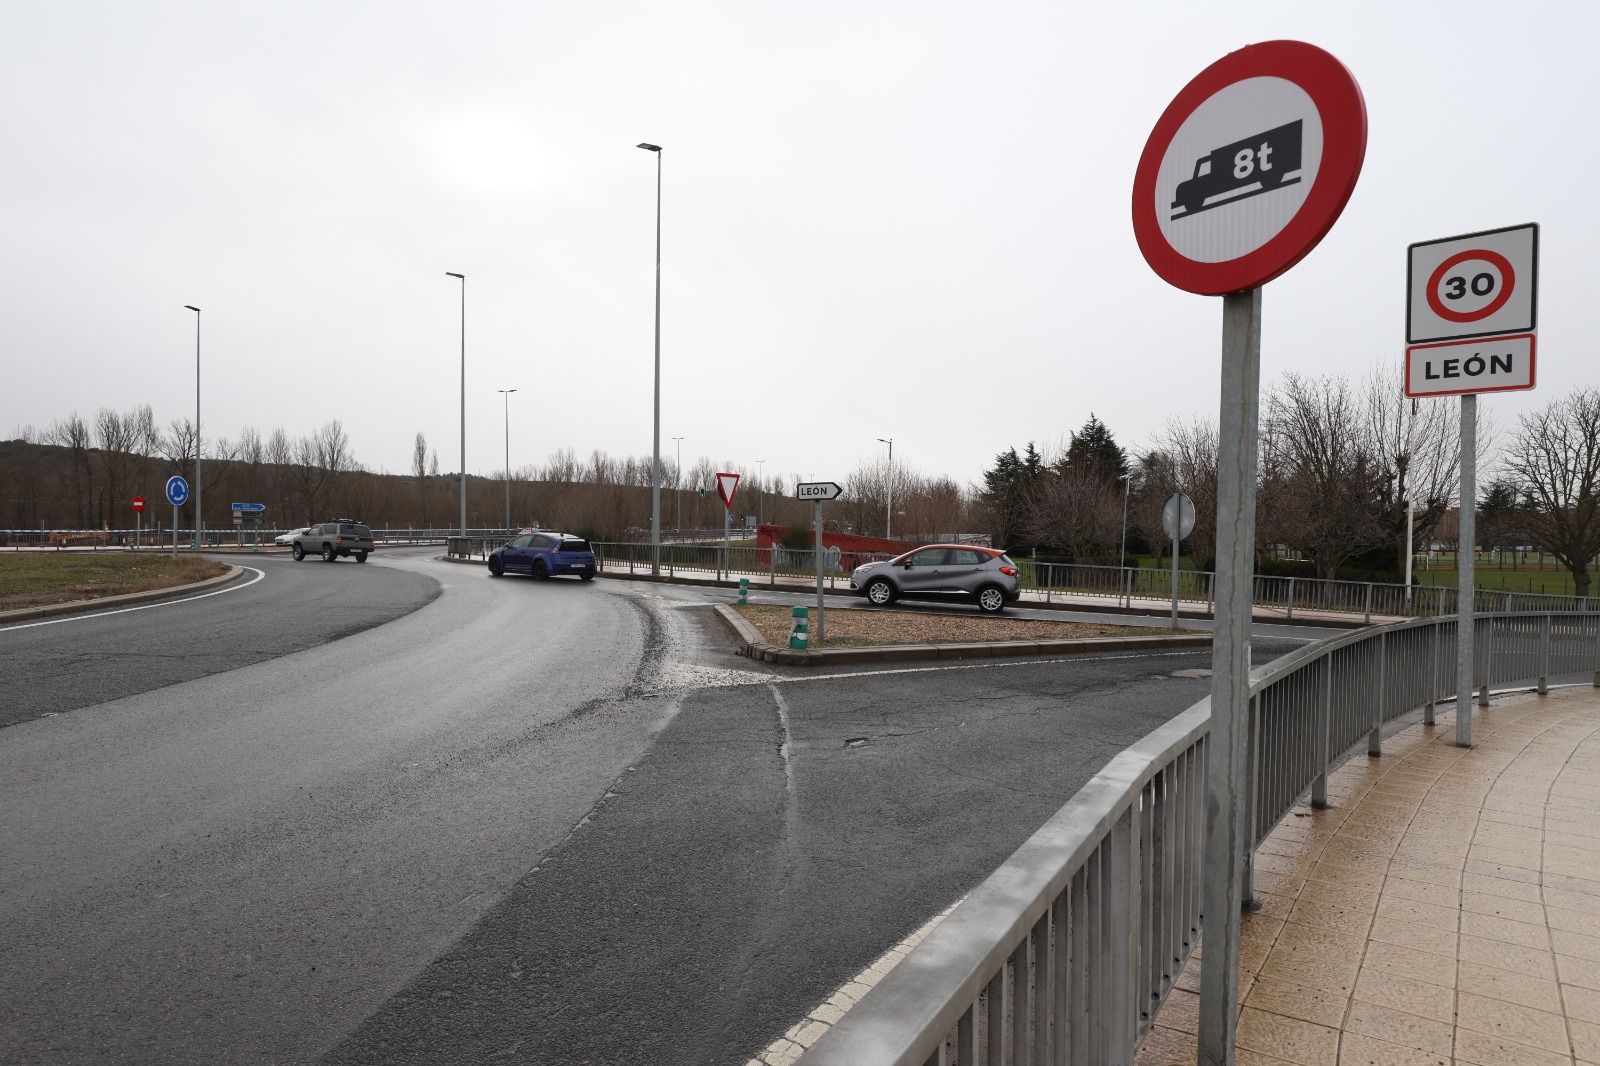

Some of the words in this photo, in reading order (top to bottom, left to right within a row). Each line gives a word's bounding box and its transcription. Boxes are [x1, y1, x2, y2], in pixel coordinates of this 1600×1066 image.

[1233, 141, 1273, 179] 8t
[1445, 272, 1495, 300] 30
[1425, 352, 1513, 380] LEÓN
[801, 485, 828, 496] LEÓN
